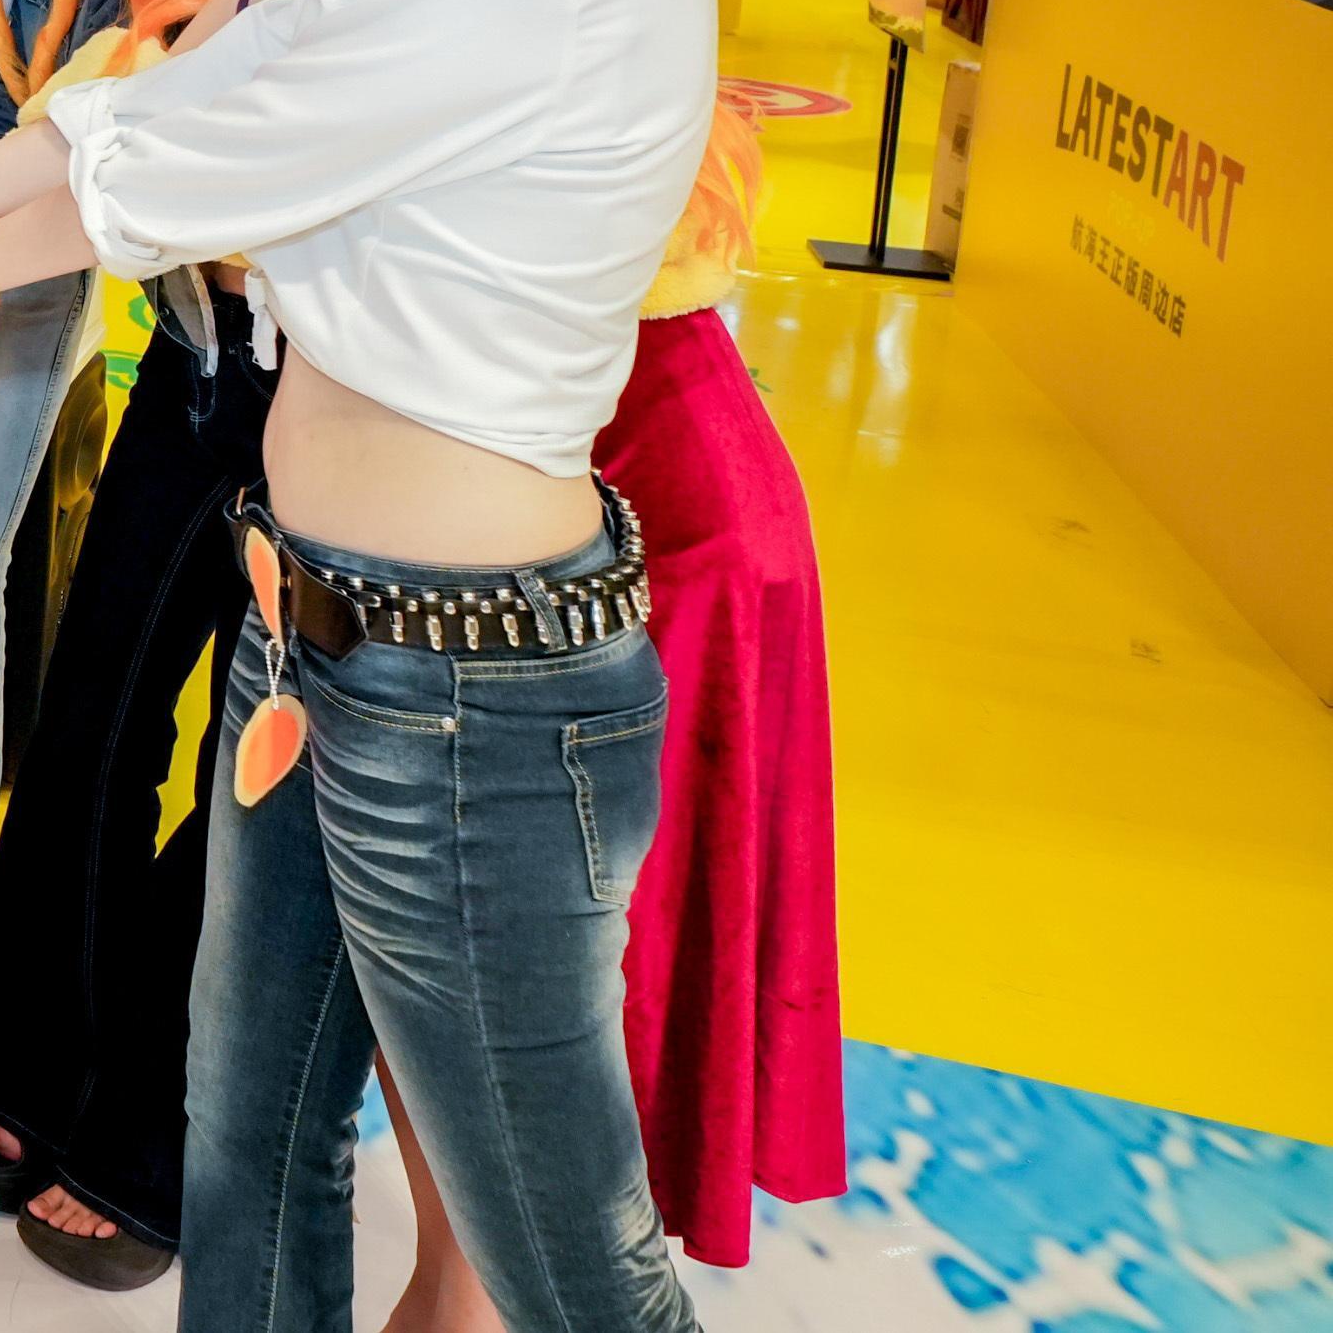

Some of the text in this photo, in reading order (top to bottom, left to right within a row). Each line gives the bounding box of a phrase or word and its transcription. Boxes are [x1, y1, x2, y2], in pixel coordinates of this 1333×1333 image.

[1055, 63, 1245, 264] LATESTART
[1069, 213, 1187, 339] 航海王正版周边店
